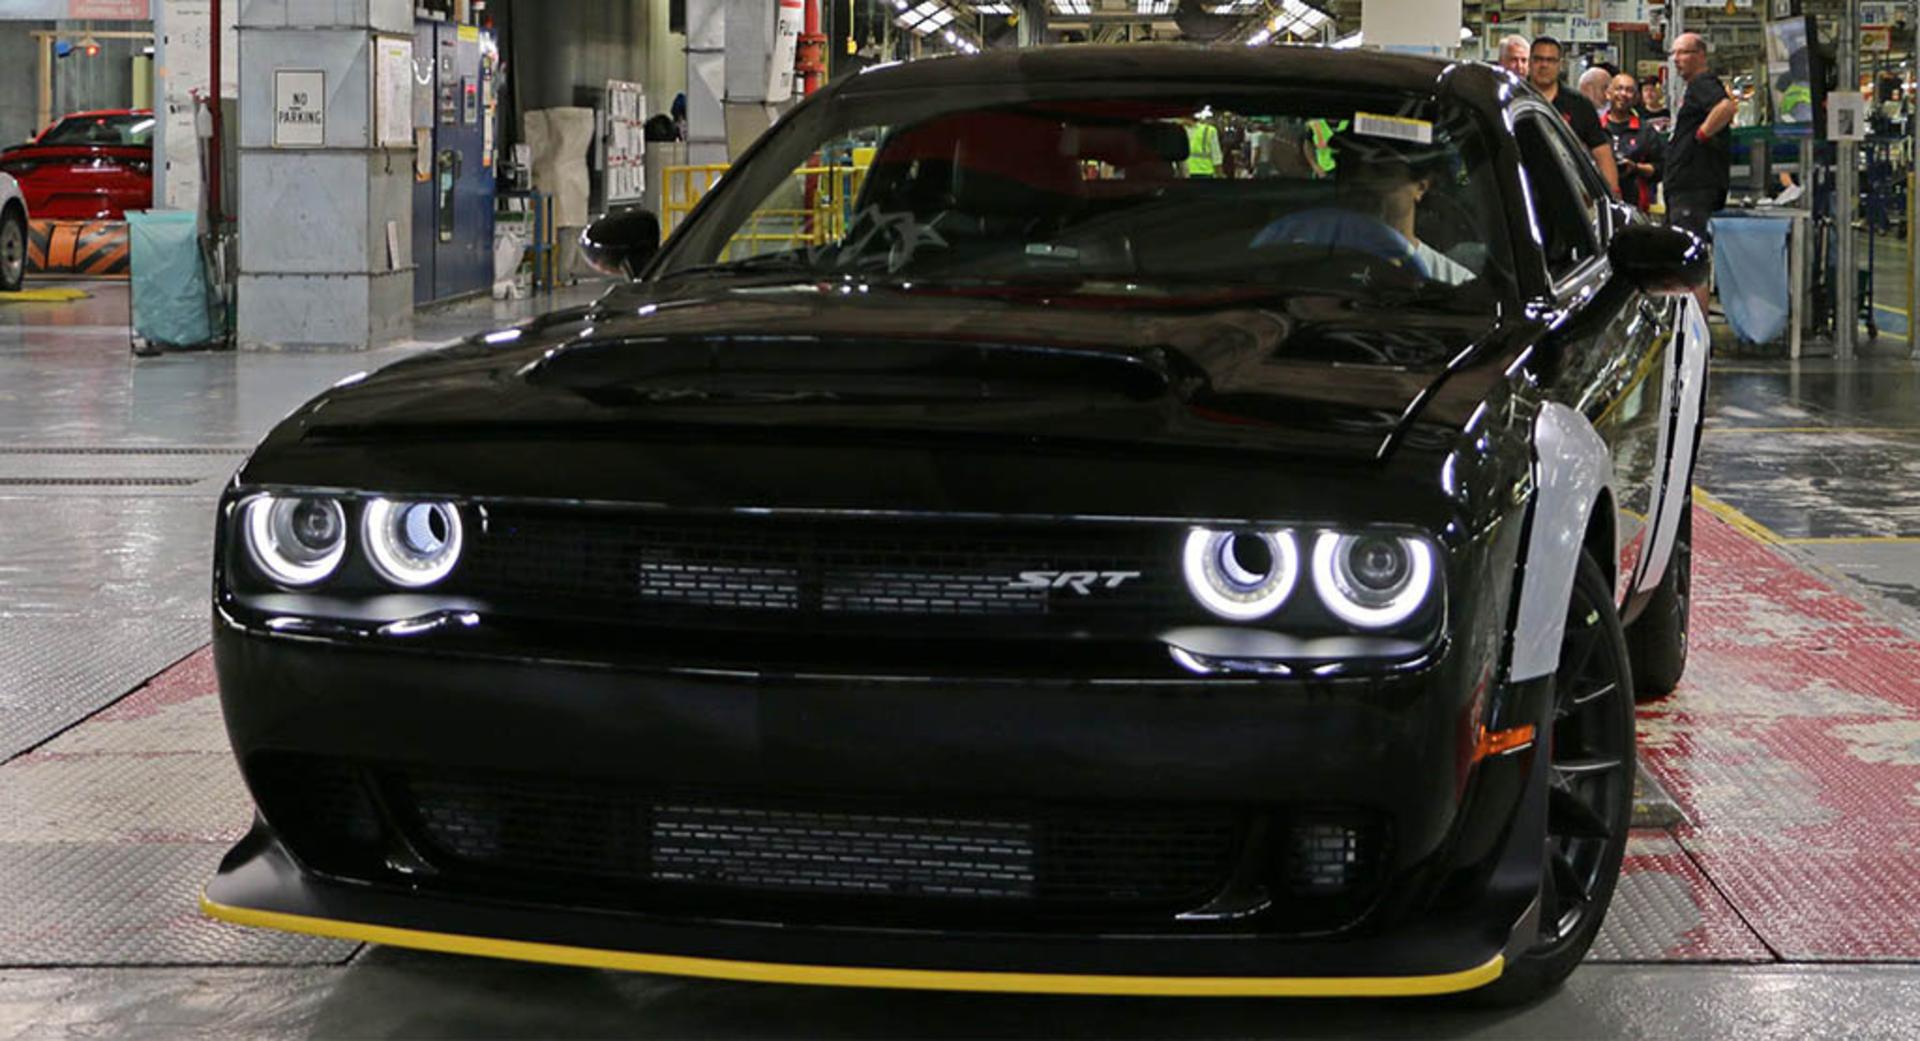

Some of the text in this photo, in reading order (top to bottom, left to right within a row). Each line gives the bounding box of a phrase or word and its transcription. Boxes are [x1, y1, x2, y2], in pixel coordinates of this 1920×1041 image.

[293, 92, 309, 106] NO
[278, 110, 322, 125] PARKING
[1008, 571, 1141, 595] SRT
